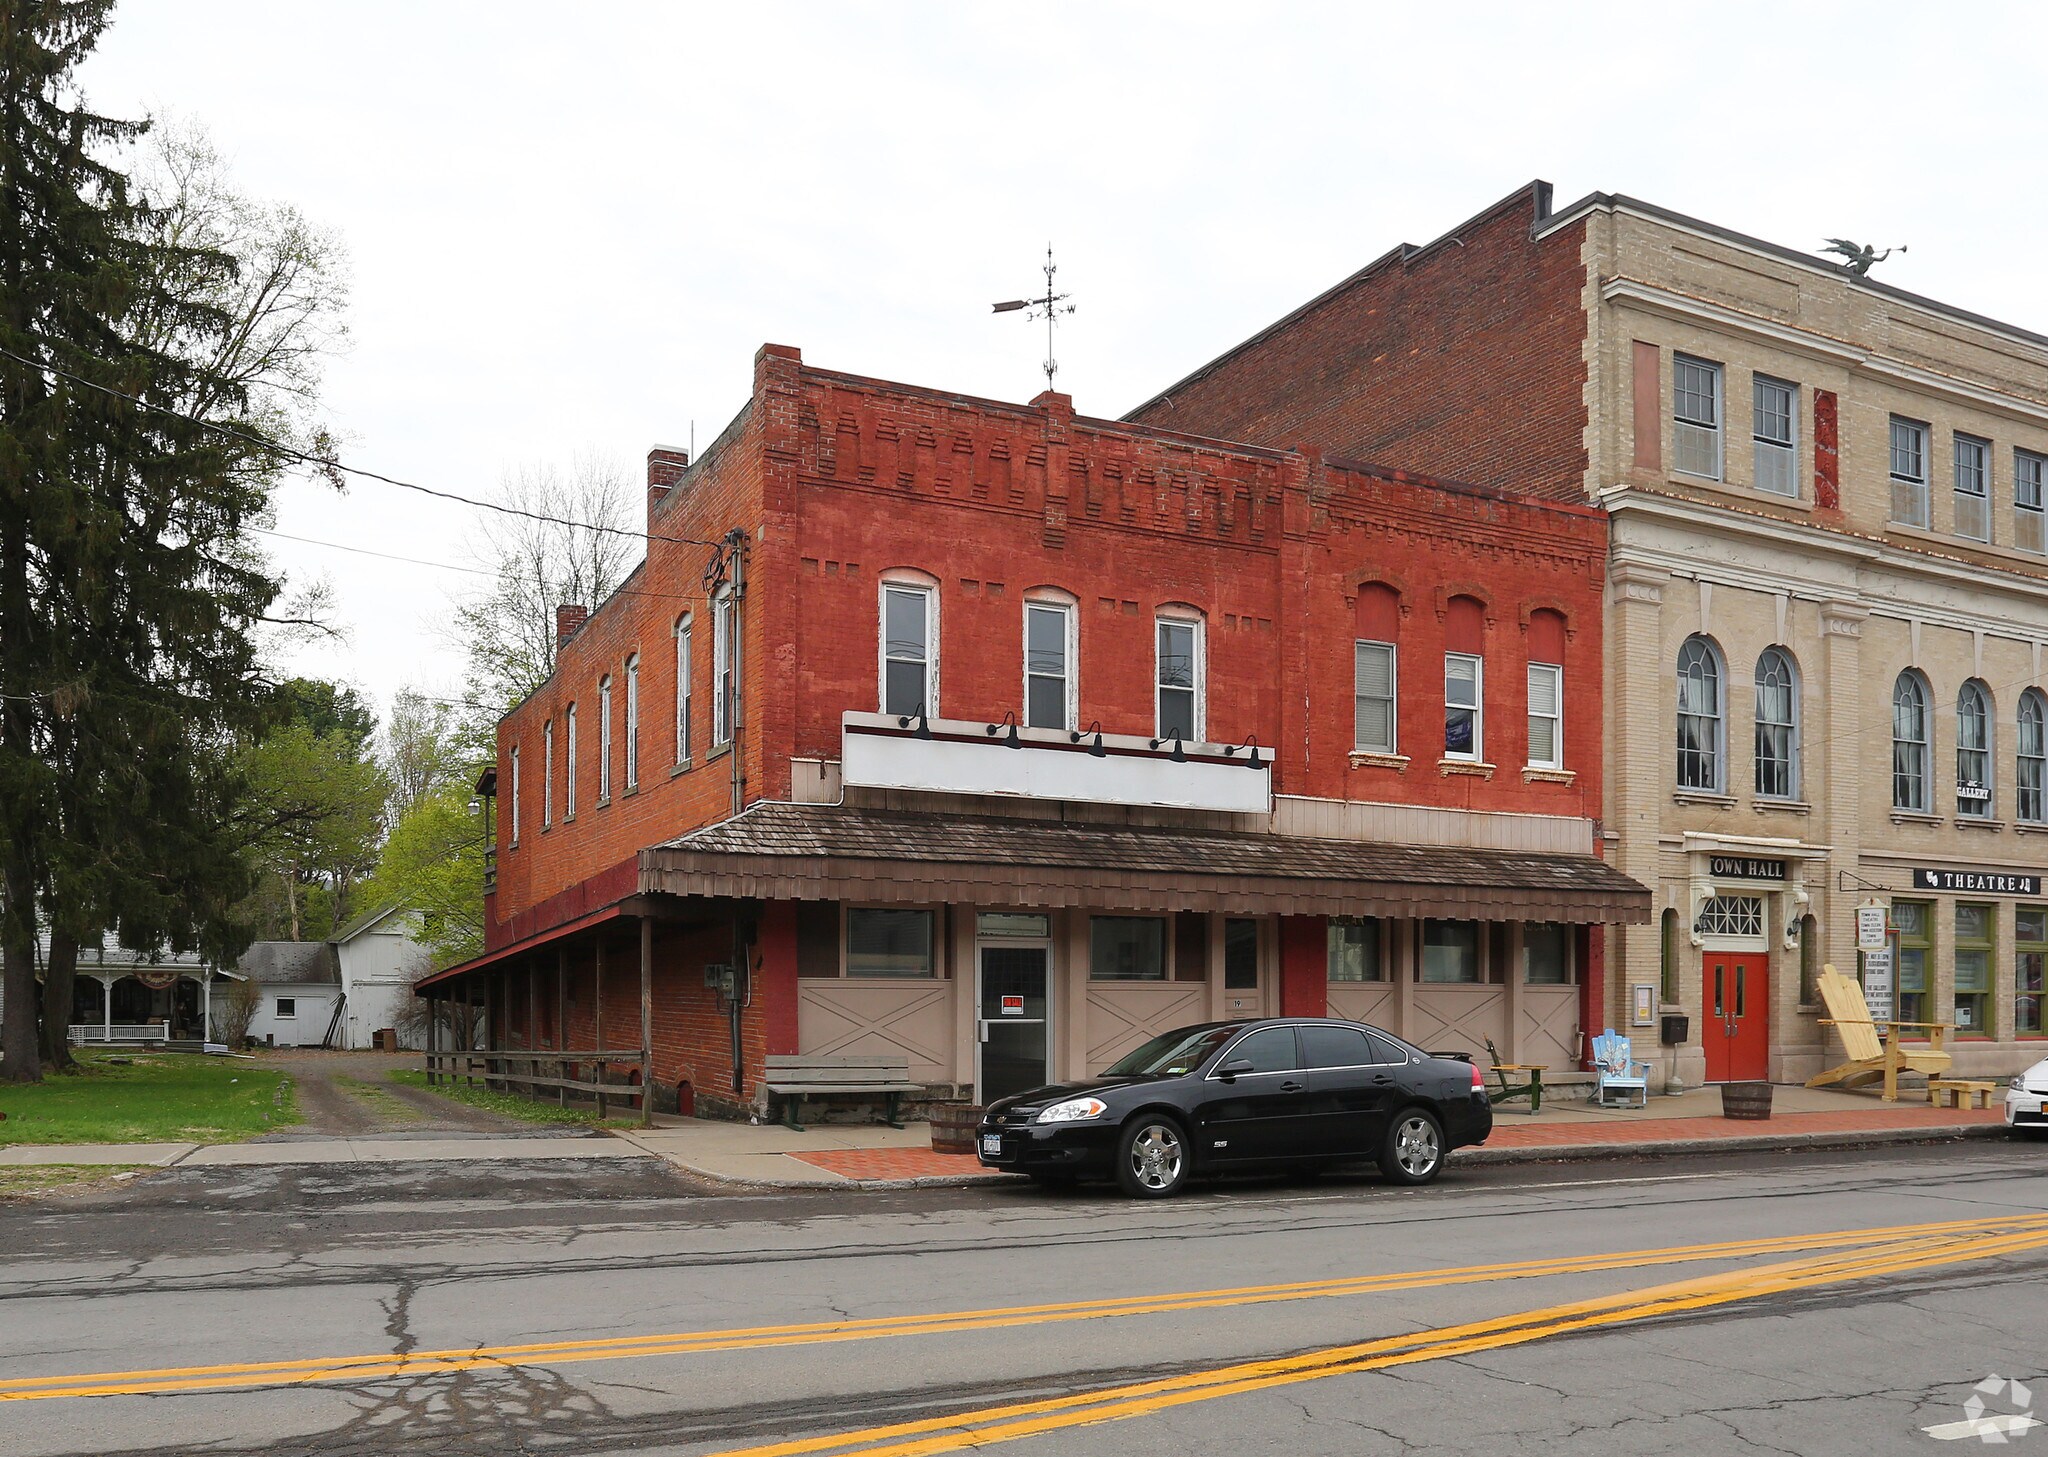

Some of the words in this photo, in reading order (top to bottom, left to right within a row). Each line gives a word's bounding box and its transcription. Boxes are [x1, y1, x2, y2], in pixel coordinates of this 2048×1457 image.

[1956, 786, 1989, 800] GALLERY
[1711, 858, 1743, 875] OWN
[1748, 861, 1783, 877] HALL
[1944, 873, 2016, 891] THEATRE
